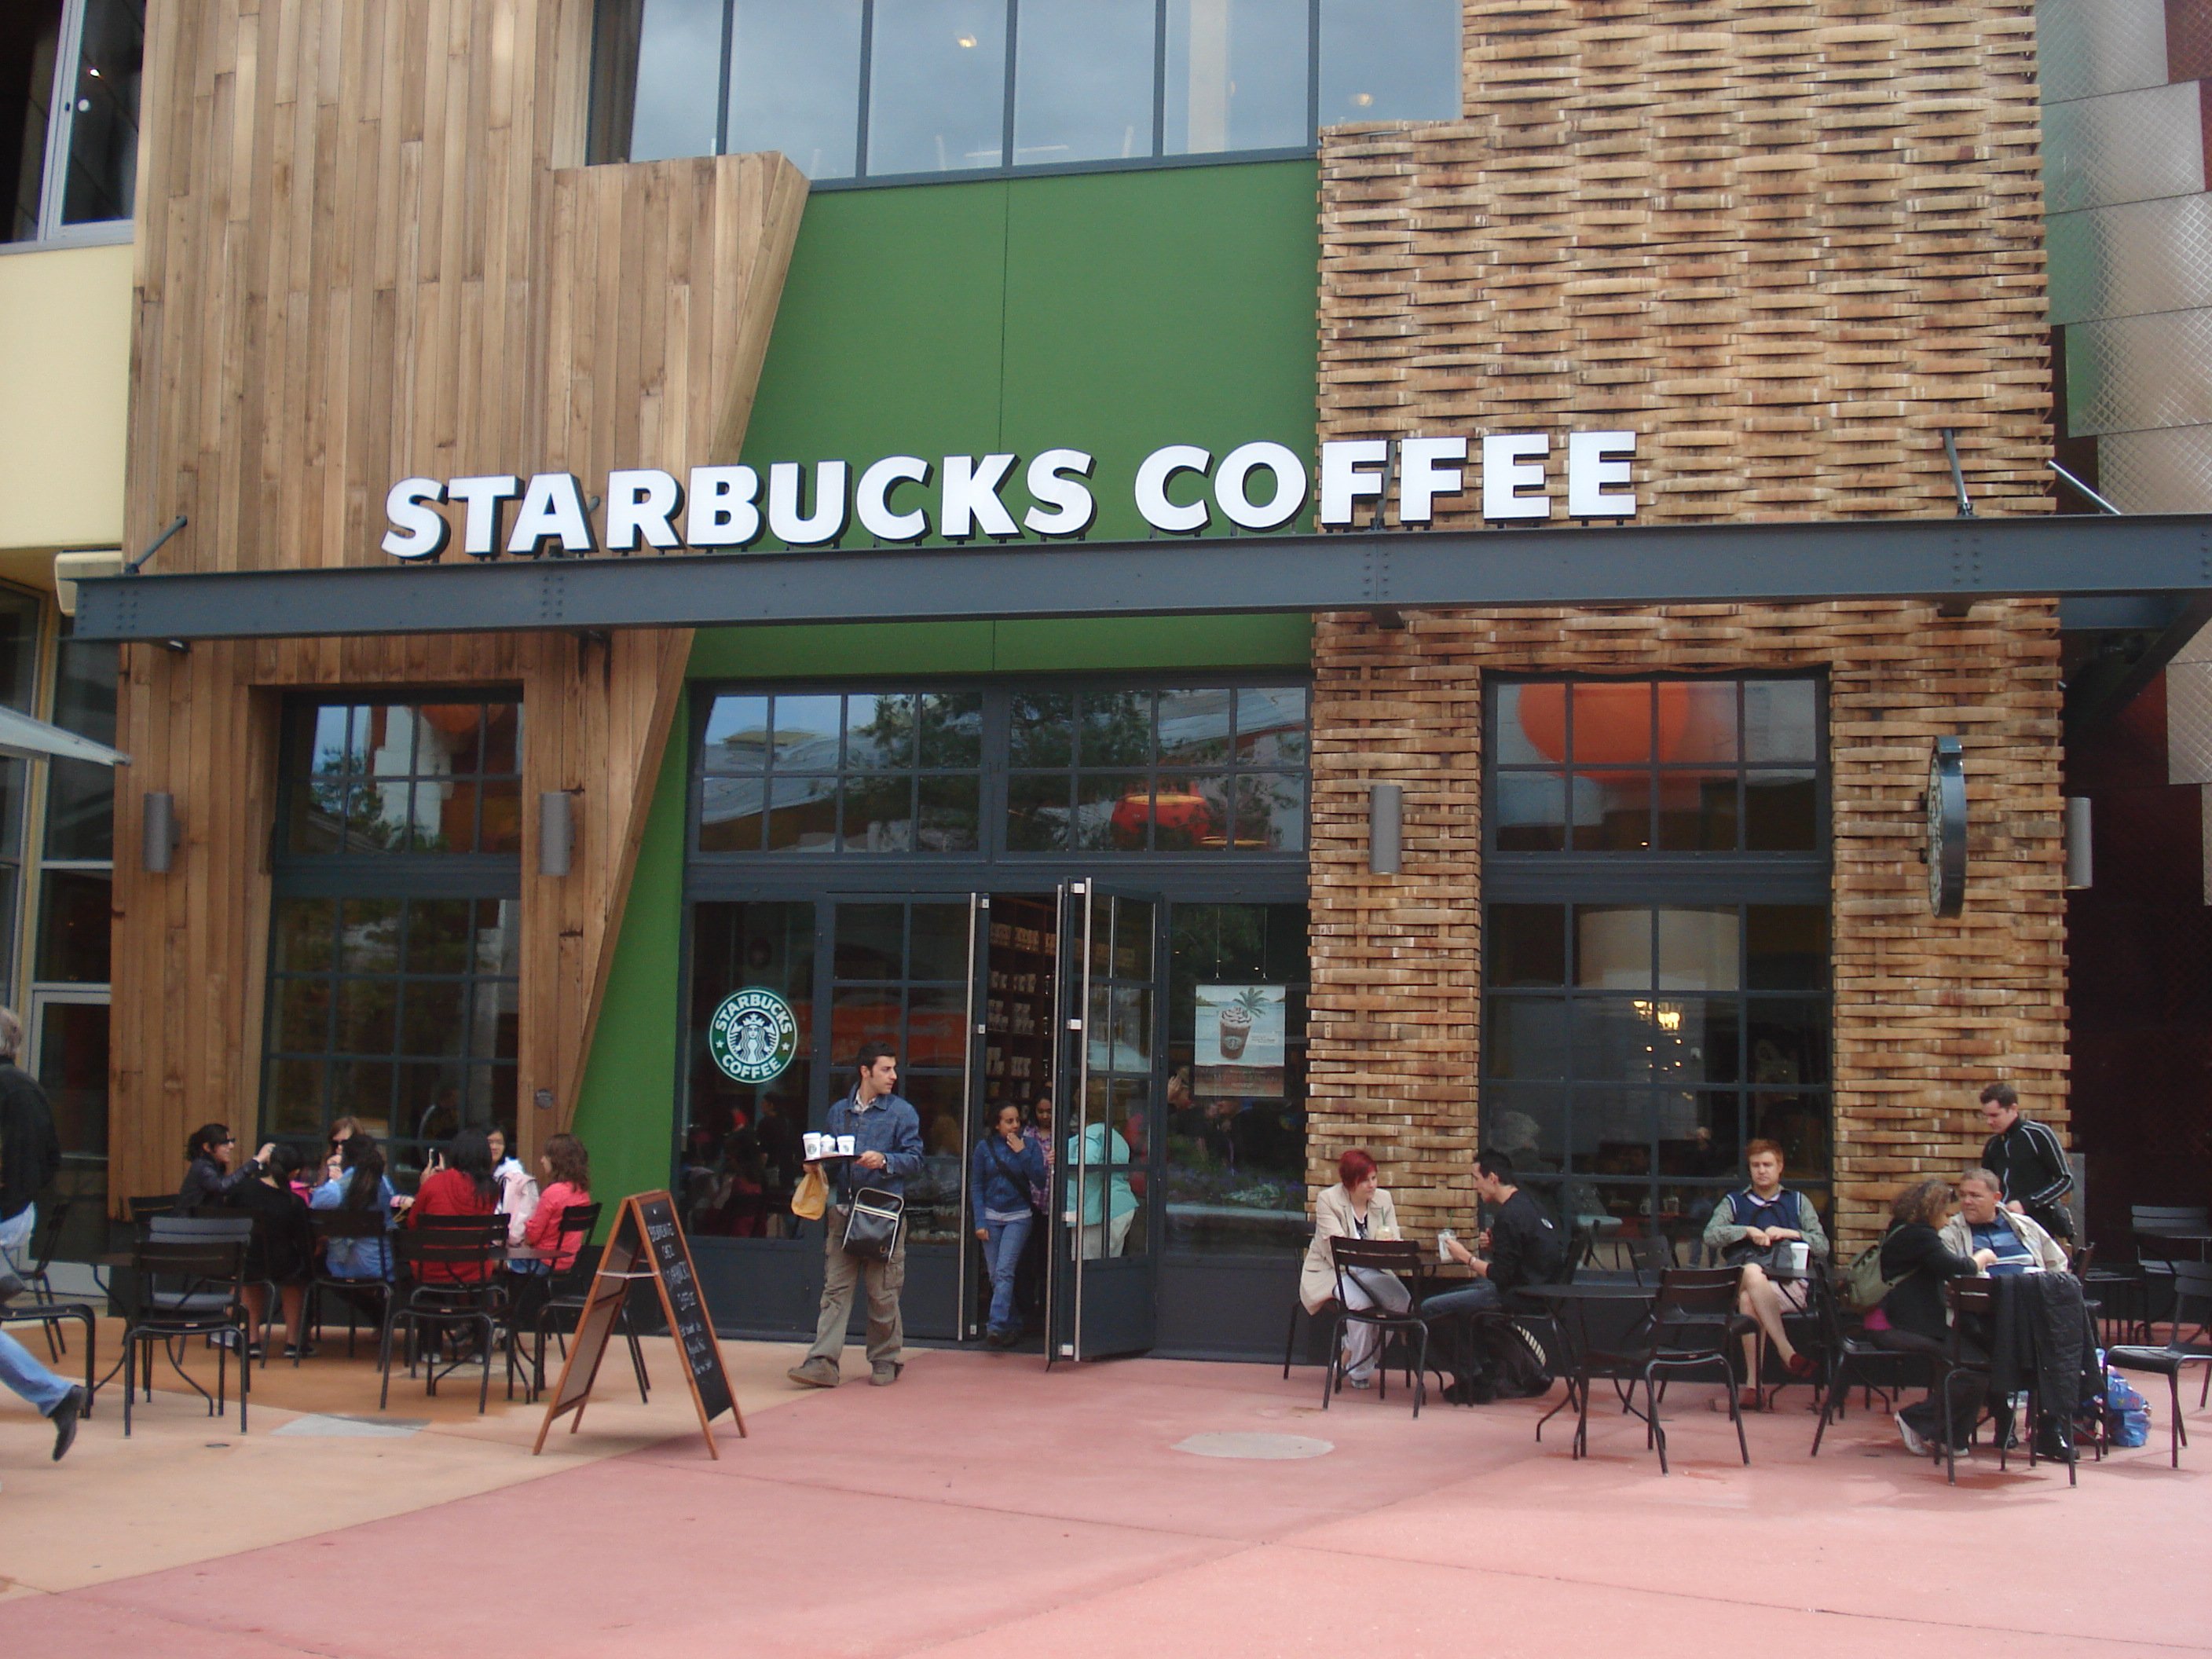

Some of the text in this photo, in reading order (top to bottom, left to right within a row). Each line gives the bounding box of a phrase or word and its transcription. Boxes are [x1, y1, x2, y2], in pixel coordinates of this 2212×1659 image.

[382, 431, 1637, 559] STARBUCKS COFFEE
[715, 994, 793, 1034] STARBUCKS
[722, 1054, 782, 1079] COFFEE
